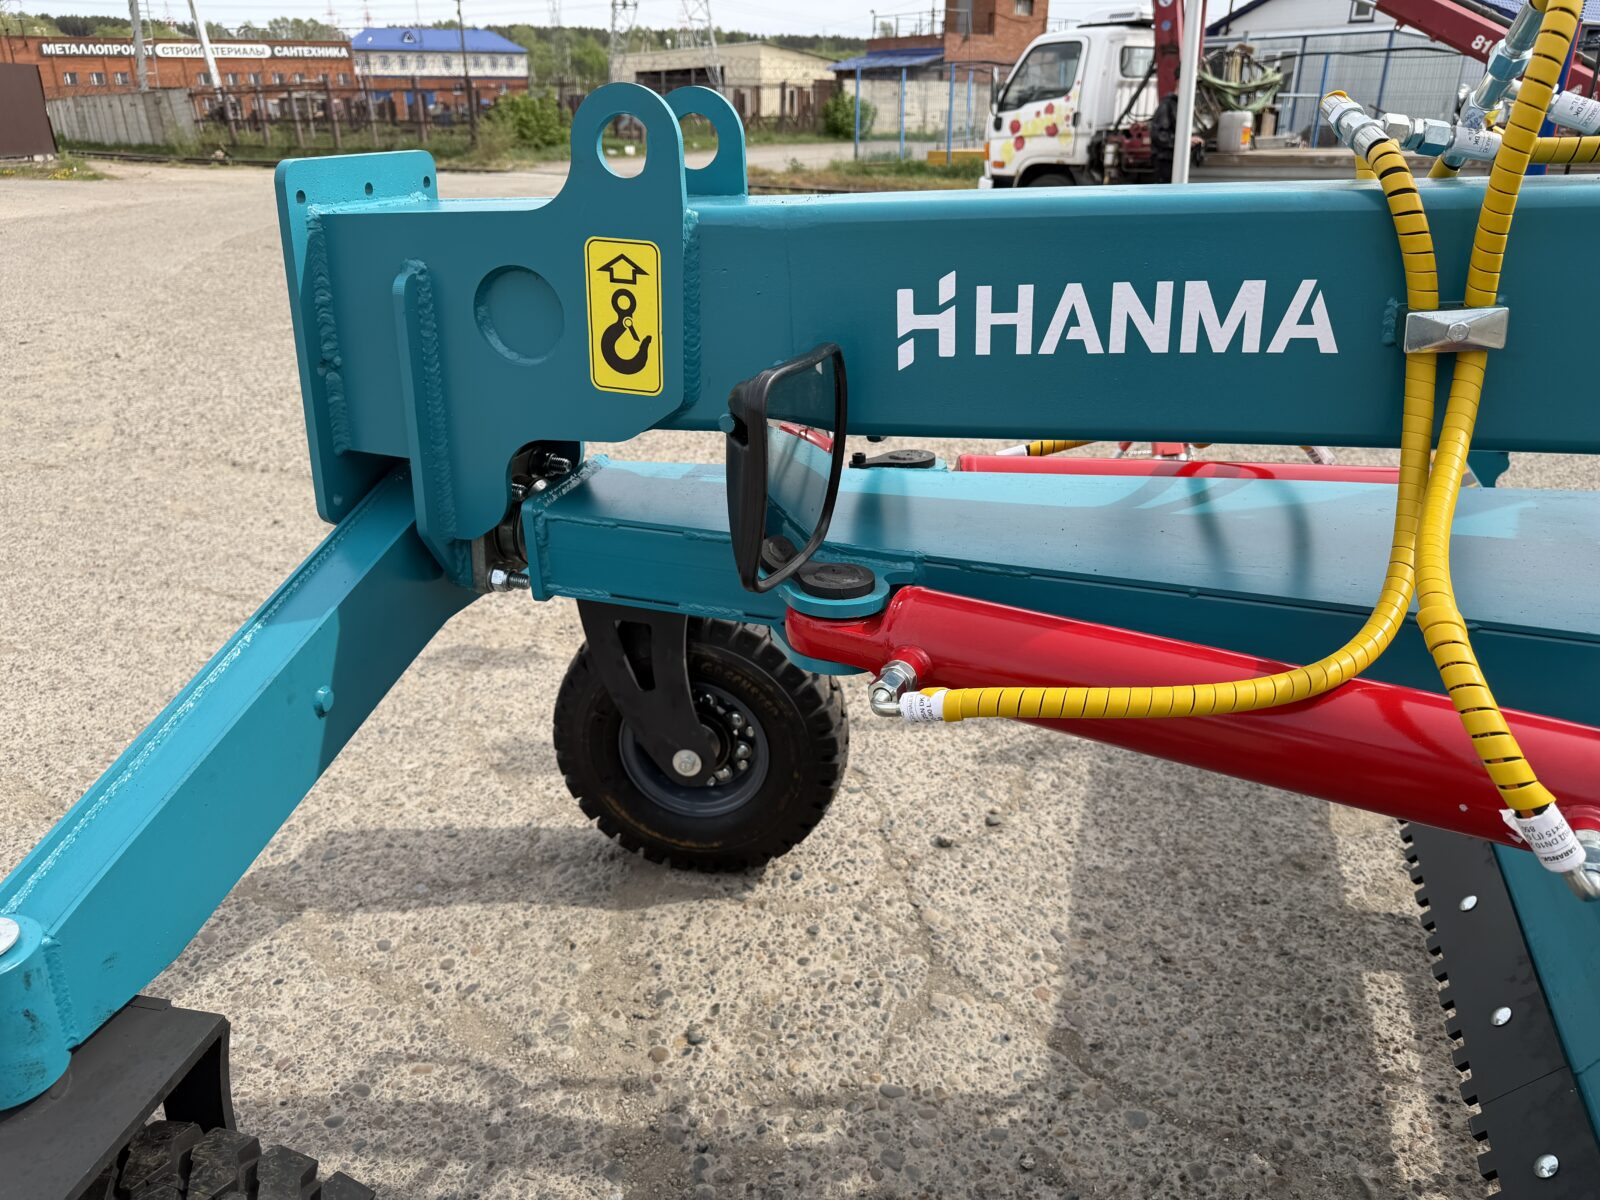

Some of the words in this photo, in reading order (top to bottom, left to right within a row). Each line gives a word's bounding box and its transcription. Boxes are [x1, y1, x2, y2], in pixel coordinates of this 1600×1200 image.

[161, 46, 266, 56] СТРОЙТЕРИАЛЫ
[273, 46, 350, 58] САНТЕХНИКА
[975, 279, 1339, 356] HANMA
